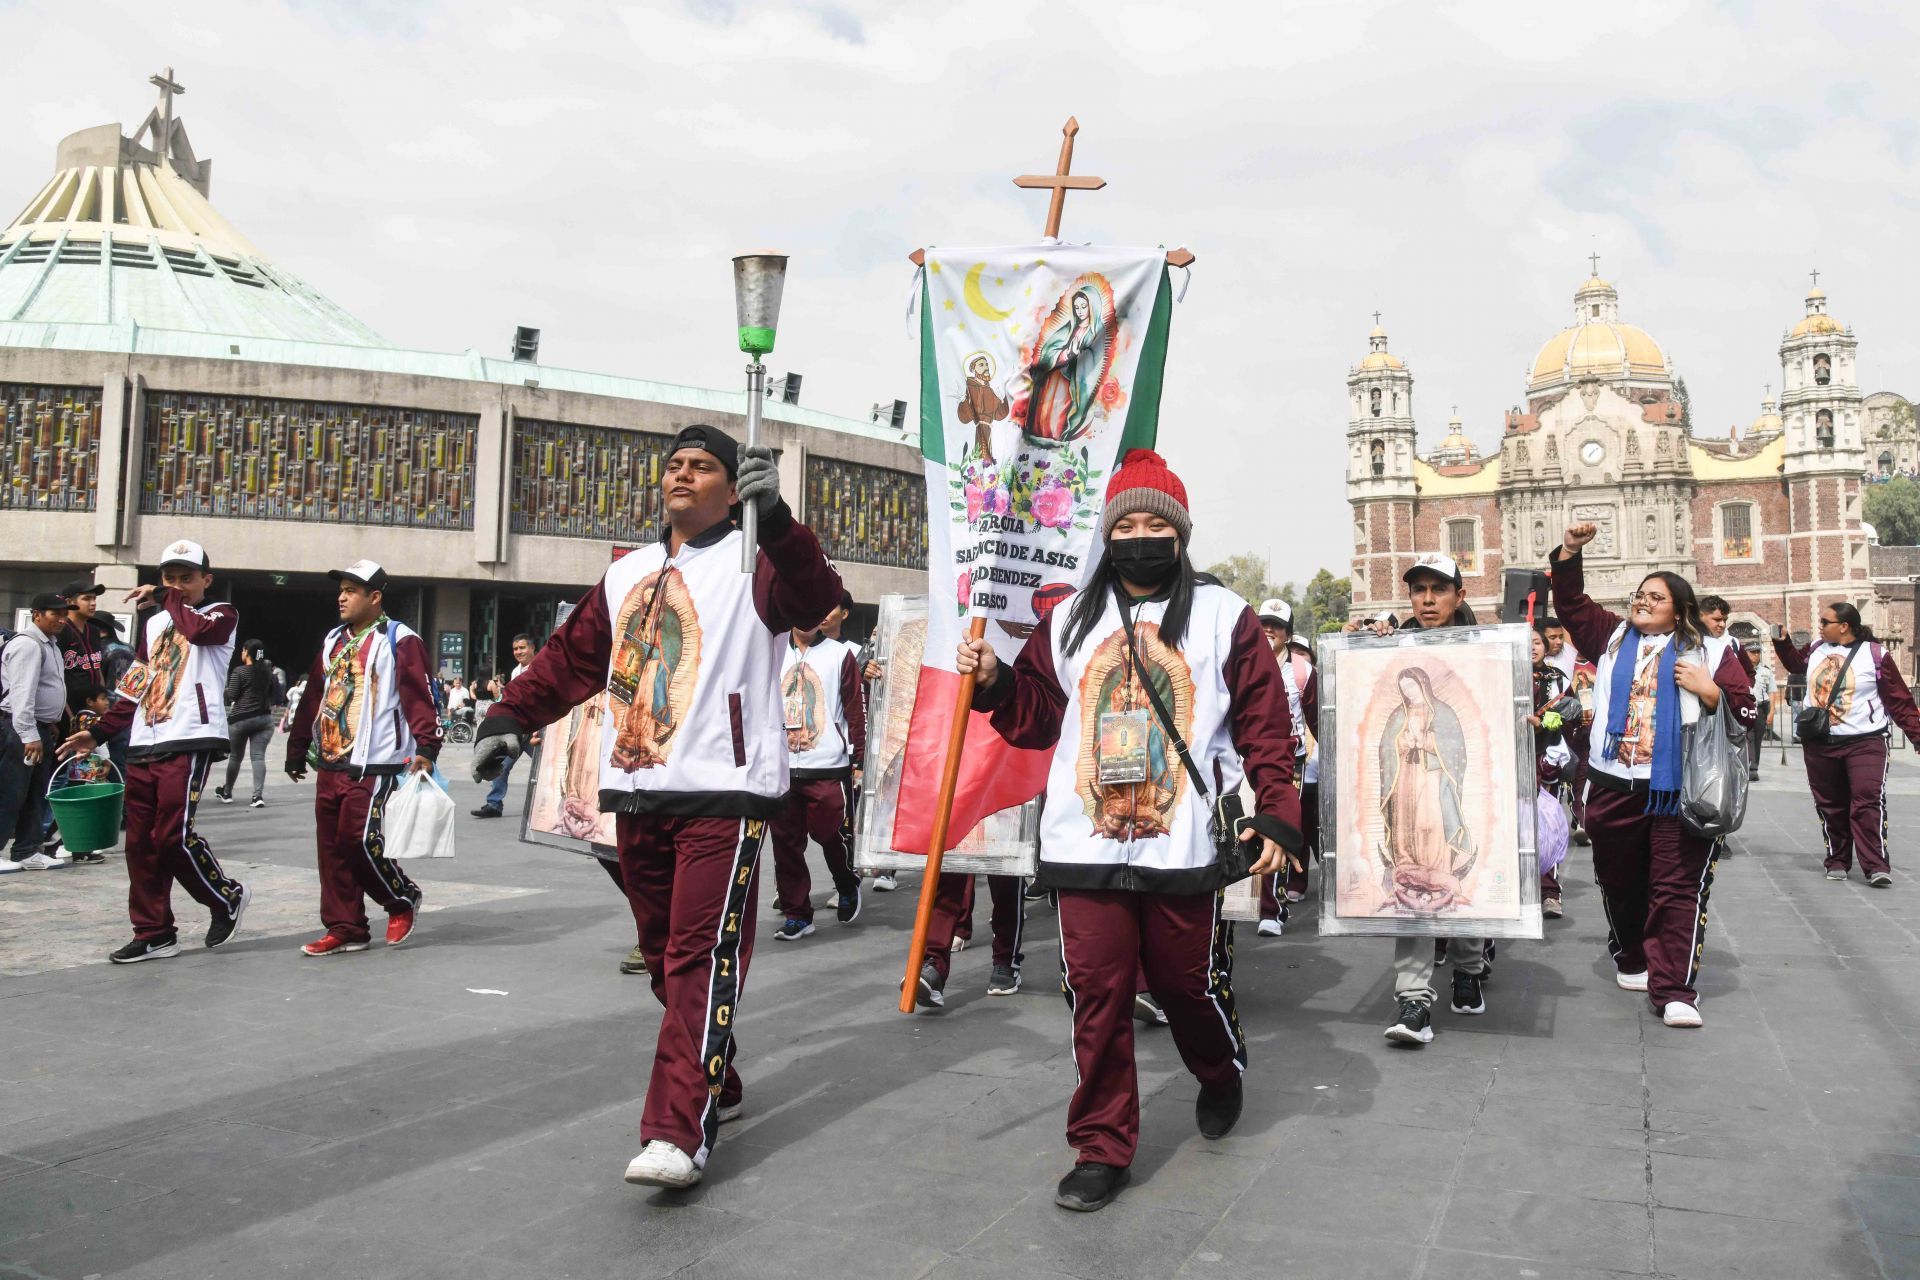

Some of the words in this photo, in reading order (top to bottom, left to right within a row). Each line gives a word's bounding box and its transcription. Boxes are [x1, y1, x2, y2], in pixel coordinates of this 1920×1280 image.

[1009, 544, 1030, 560] DE
[1031, 548, 1079, 570] ASIS
[709, 819, 763, 1077] MEXICO
